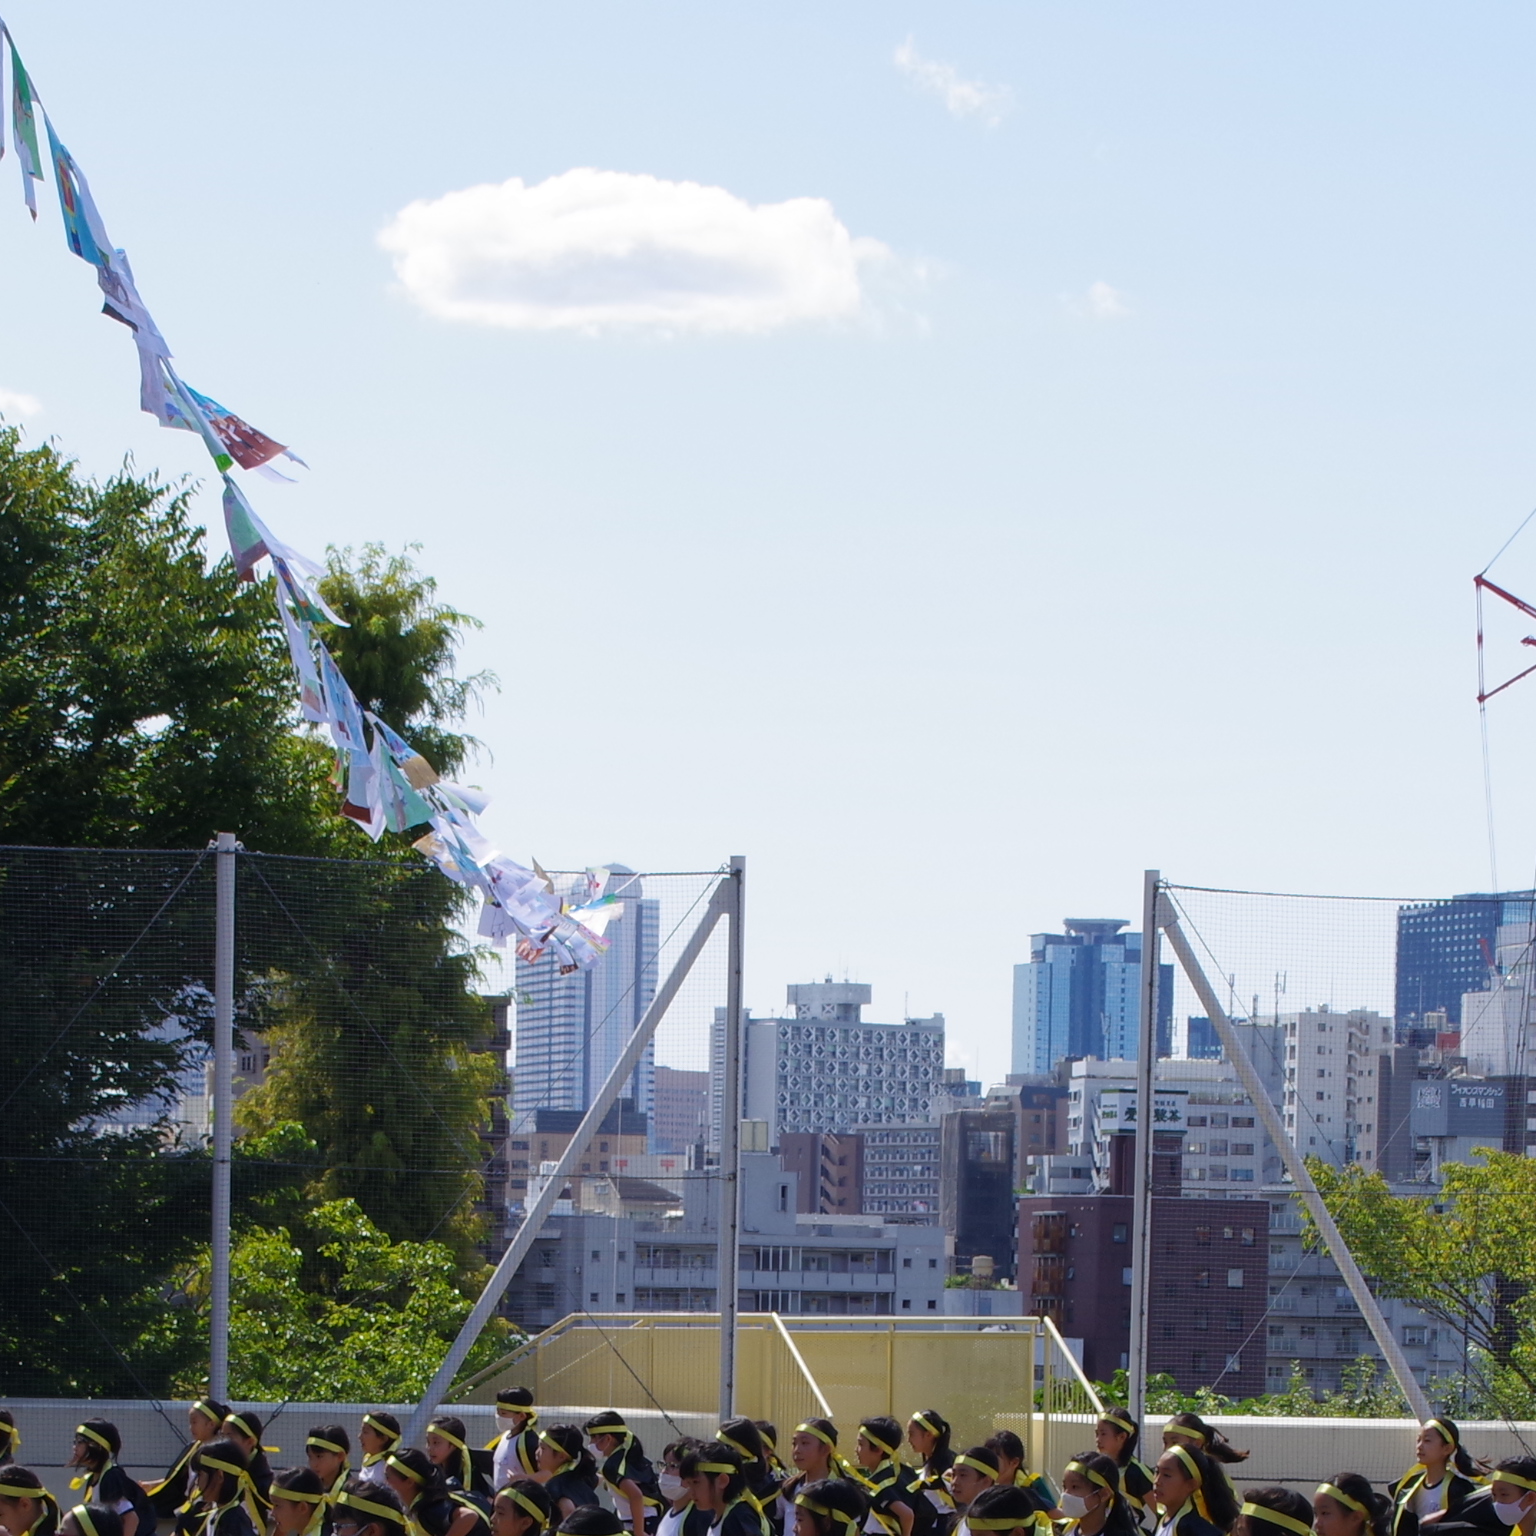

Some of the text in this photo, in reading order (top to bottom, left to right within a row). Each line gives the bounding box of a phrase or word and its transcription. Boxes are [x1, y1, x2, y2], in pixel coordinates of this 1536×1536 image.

[1450, 1083, 1504, 1097] ライオンズマンション
[1459, 1097, 1495, 1109] 西早稲田
[1124, 1107, 1182, 1123] 愛製茶
